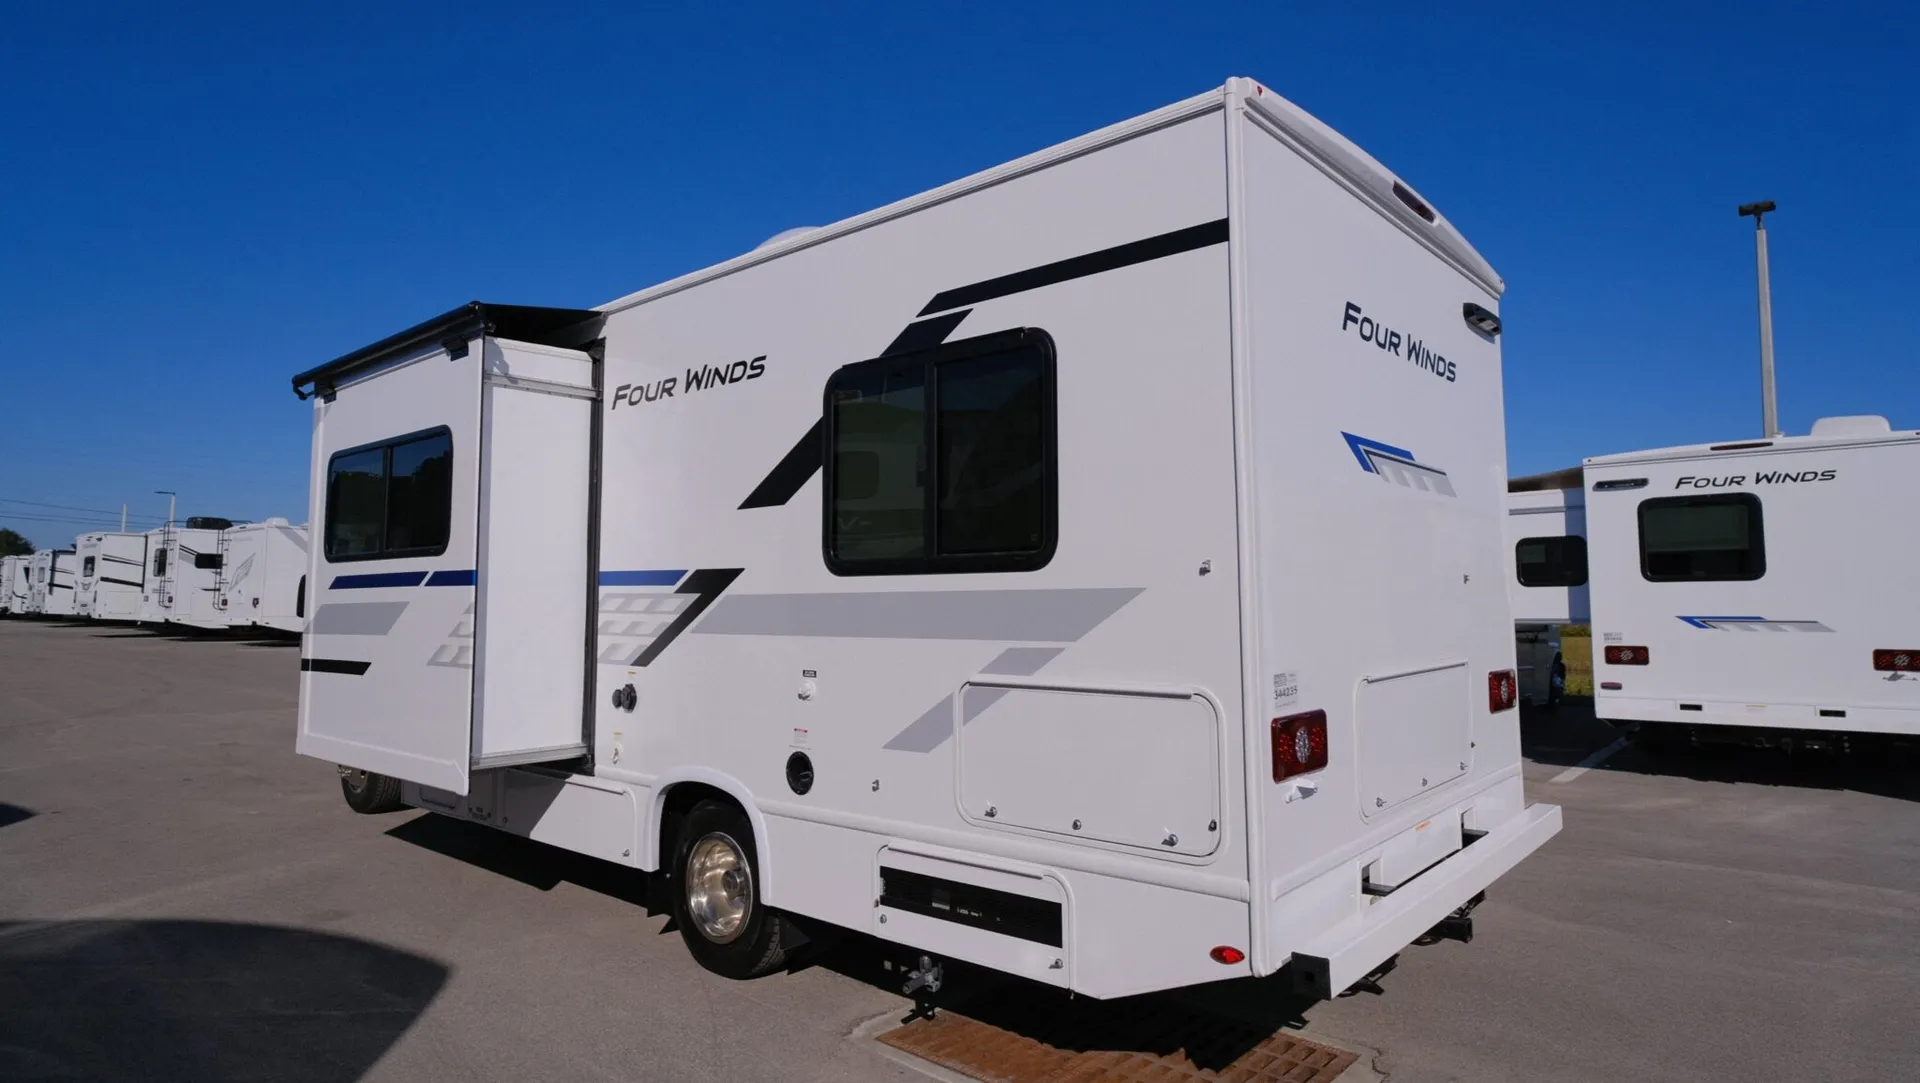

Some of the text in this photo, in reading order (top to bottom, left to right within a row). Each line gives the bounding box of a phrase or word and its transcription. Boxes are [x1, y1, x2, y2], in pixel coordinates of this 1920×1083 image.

[1342, 300, 1457, 383] FOUR WINDS
[611, 355, 768, 411] FOUR WINDS
[1674, 470, 1837, 490] FOUR WINDS
